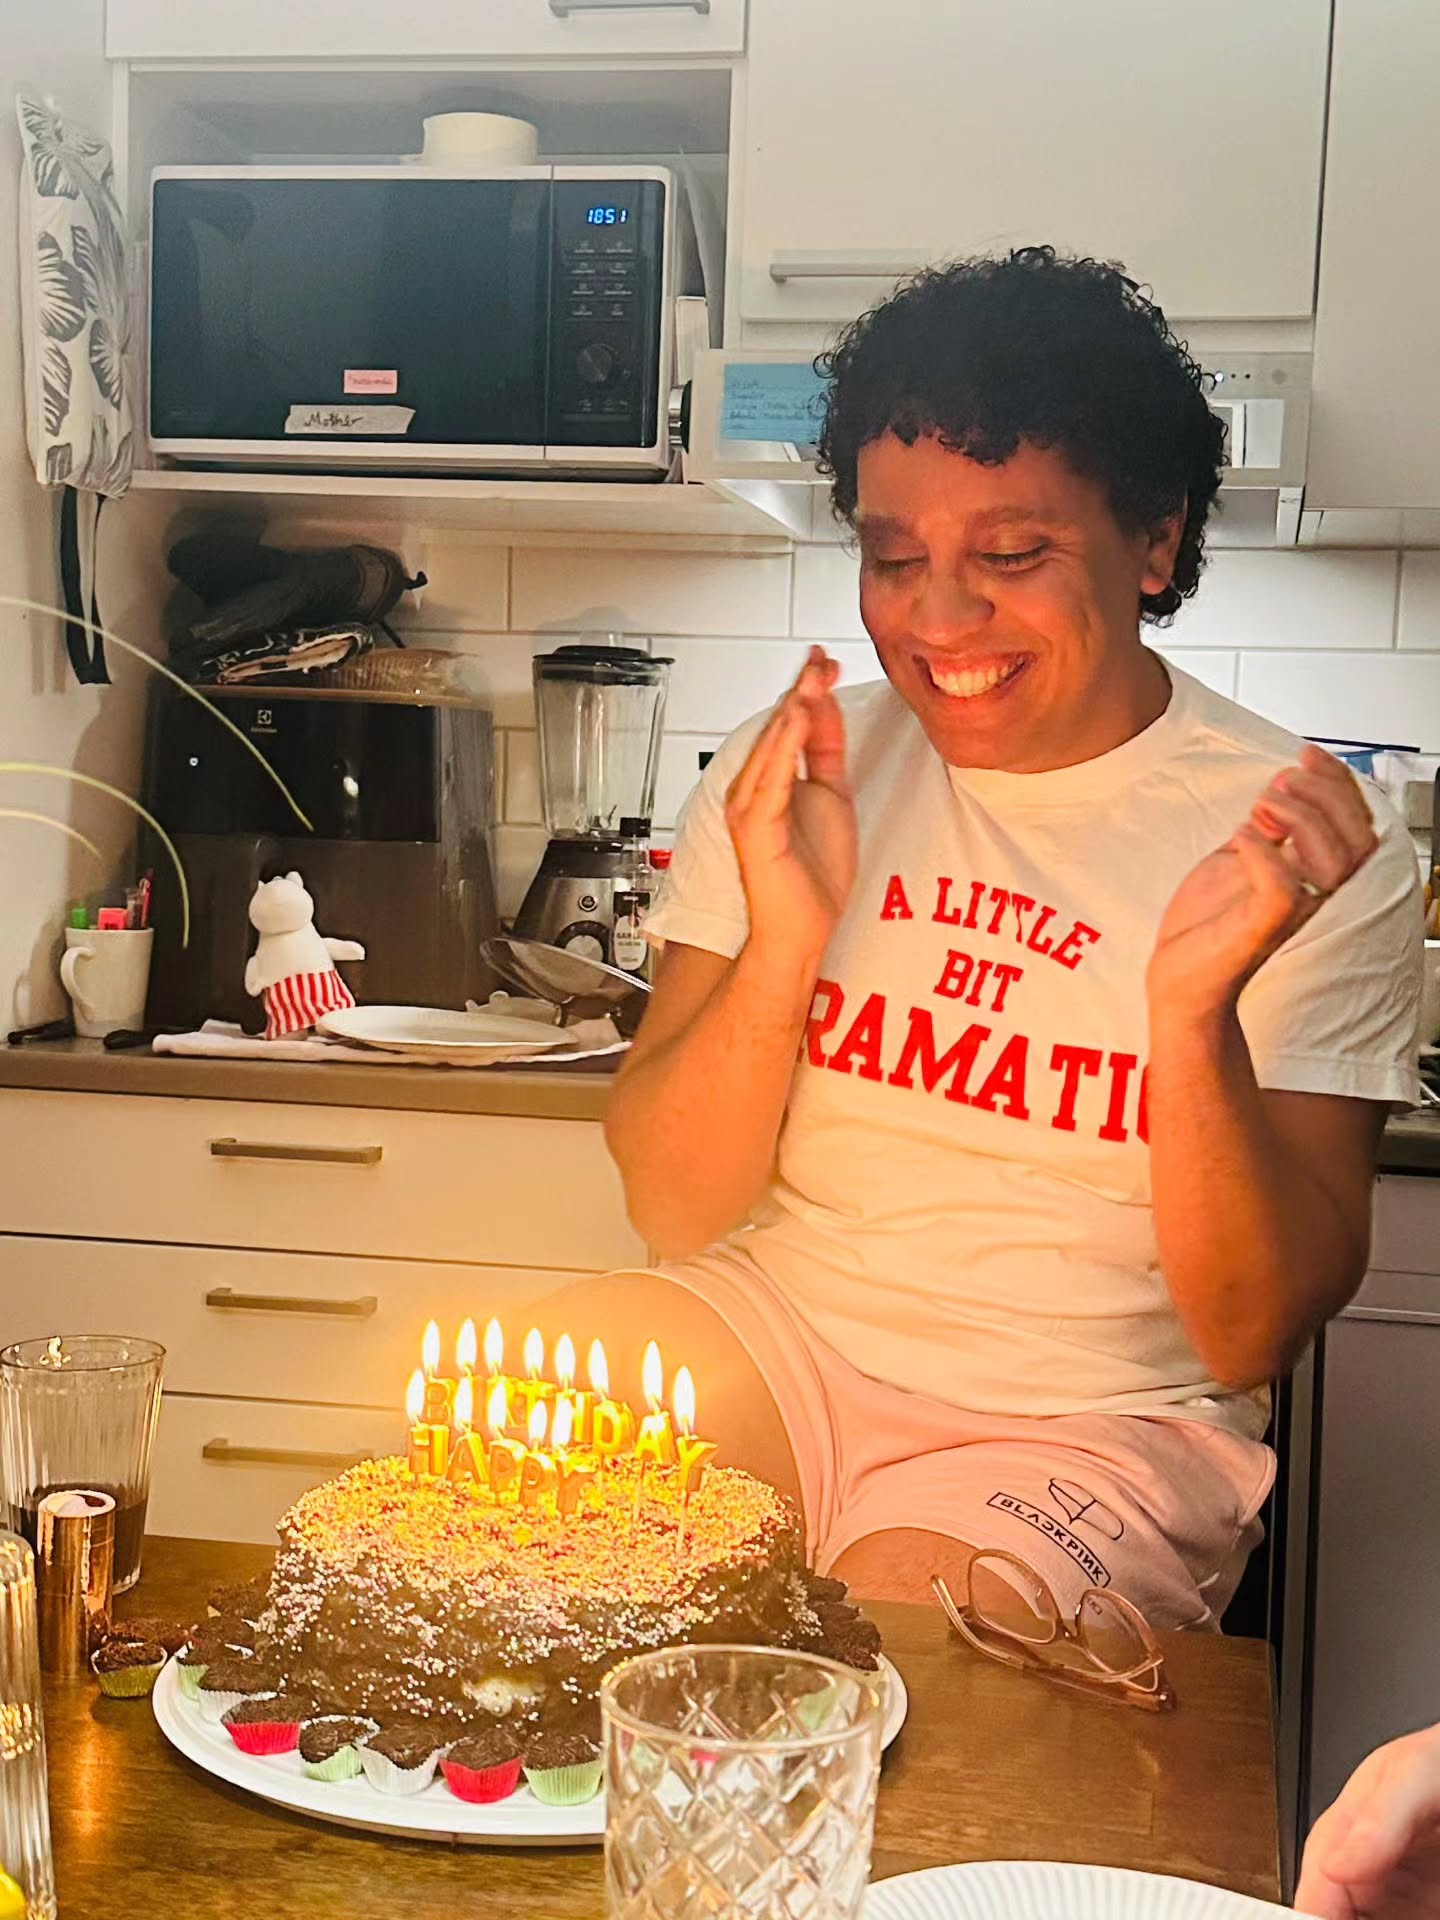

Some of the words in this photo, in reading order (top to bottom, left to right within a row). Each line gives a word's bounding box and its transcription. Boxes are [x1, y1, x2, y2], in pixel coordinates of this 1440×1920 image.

[587, 208, 627, 224] 1851
[880, 875, 913, 920] A
[931, 877, 1101, 970] LITTLE
[933, 949, 1024, 1013] BIT
[408, 1422, 597, 1510] HAPPY
[424, 1373, 718, 1492] BTHDAY
